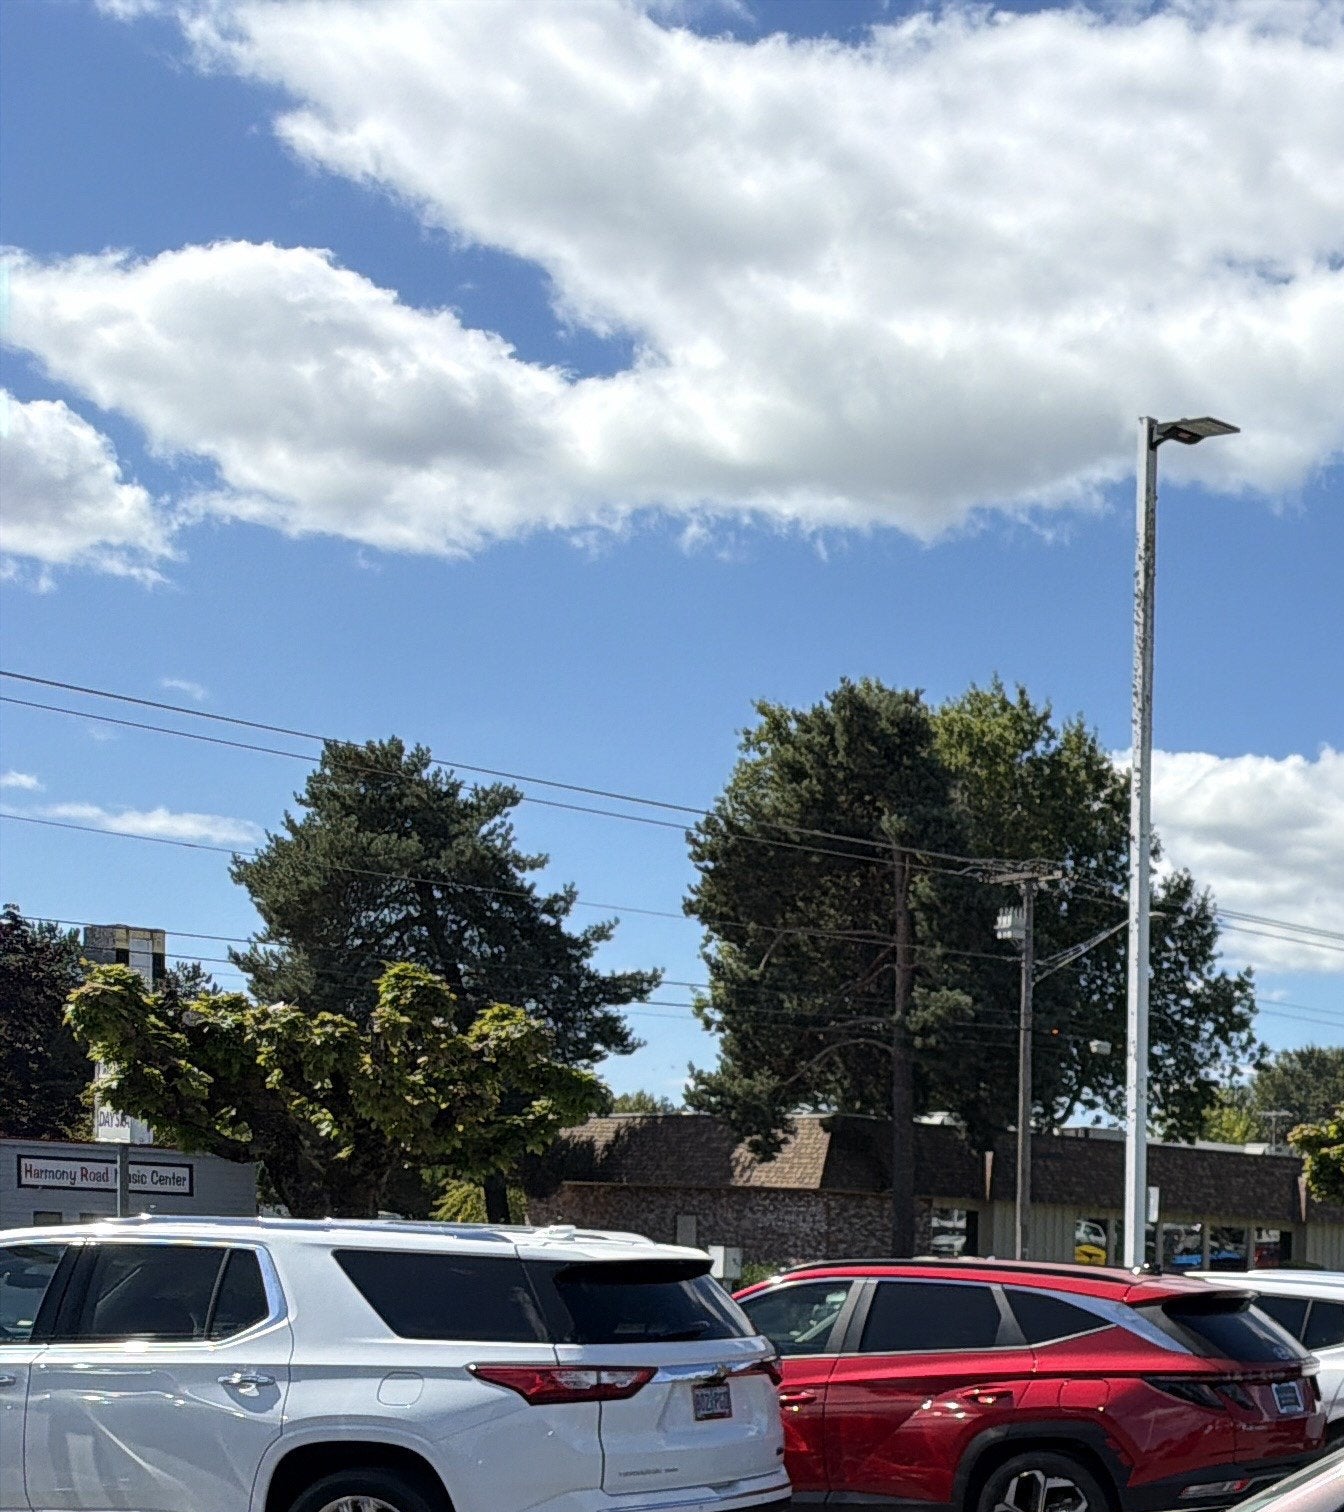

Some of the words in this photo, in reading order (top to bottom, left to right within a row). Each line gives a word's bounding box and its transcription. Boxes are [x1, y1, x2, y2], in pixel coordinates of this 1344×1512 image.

[24, 1163, 77, 1185] Harmony
[80, 1166, 109, 1183] Road
[114, 1168, 147, 1186] sic
[150, 1169, 187, 1187] Center
